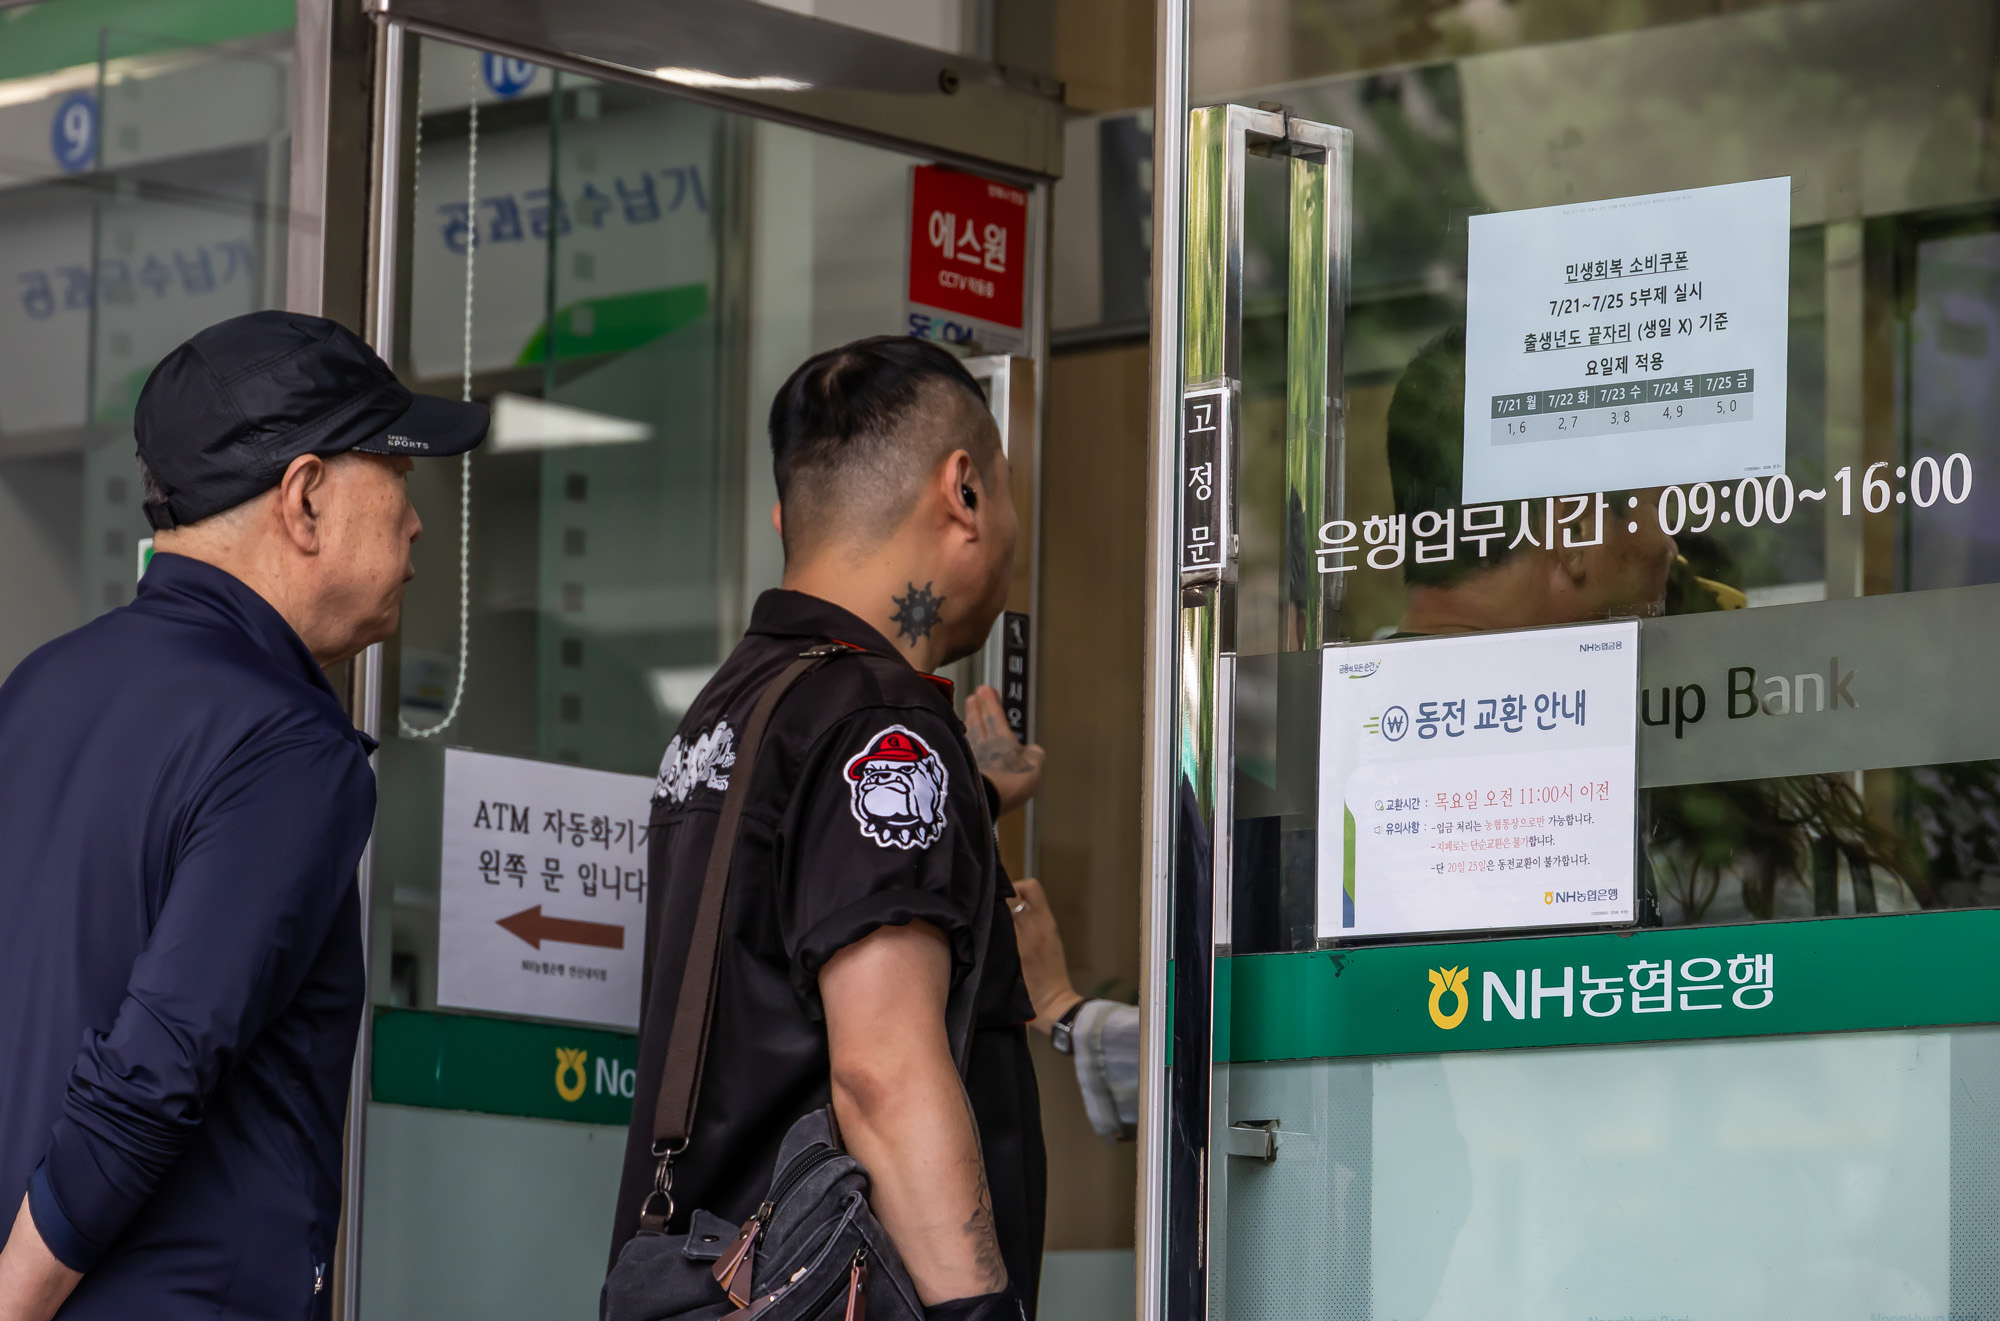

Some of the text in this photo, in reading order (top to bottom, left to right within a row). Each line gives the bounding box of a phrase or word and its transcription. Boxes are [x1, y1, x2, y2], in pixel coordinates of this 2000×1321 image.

[63, 104, 90, 160] 9
[929, 210, 1007, 273] 에스원
[939, 270, 967, 290] CCTV
[1566, 251, 1688, 282] 민생회복 소비쿠폰
[1550, 281, 1703, 316] 7/21~7/25 5부제 실시
[1524, 312, 1728, 352] 출생년도 끝자리 (생일 X) 기준
[1585, 352, 1664, 377] 요일제 적용
[1497, 374, 1748, 413] 7/21 월 7/22 화 7/23 수 7/24 목 7/25 금
[1187, 404, 1216, 563] 고정문
[1315, 493, 1605, 573] 은행업무시간
[1657, 453, 1972, 536] 09:00~16:00
[1579, 641, 1622, 653] NH농협금융
[1354, 664, 1363, 672] 모든
[1364, 662, 1375, 672] 순간
[1727, 656, 1861, 719] Bank
[1416, 700, 1465, 740] 동전
[1474, 694, 1527, 734] 교환
[1534, 689, 1586, 730] 안내
[1386, 797, 1420, 811] 교환시간
[1434, 790, 1478, 812] 목요일
[1483, 787, 1513, 808] 오전
[1520, 783, 1573, 805] 11:00시
[1580, 781, 1609, 802] 이전
[474, 800, 530, 835] ATM
[1386, 822, 1420, 835] 유의사항
[1456, 821, 1482, 833] 처리는
[1484, 817, 1545, 831] 농협통장으로만
[1548, 813, 1594, 828] 가능합니다.
[1470, 838, 1510, 851] 단순교환은
[1513, 835, 1555, 848] 불가합니다.
[478, 849, 647, 903] 왼쪽 문 입니다
[1447, 862, 1465, 873] 20일
[1468, 860, 1495, 872] 25일은
[1497, 857, 1541, 870] 동전교환이
[1544, 854, 1590, 867] 불가합니다.
[1555, 888, 1618, 904] NH농협은행
[1483, 953, 1773, 1022] NH농협은행
